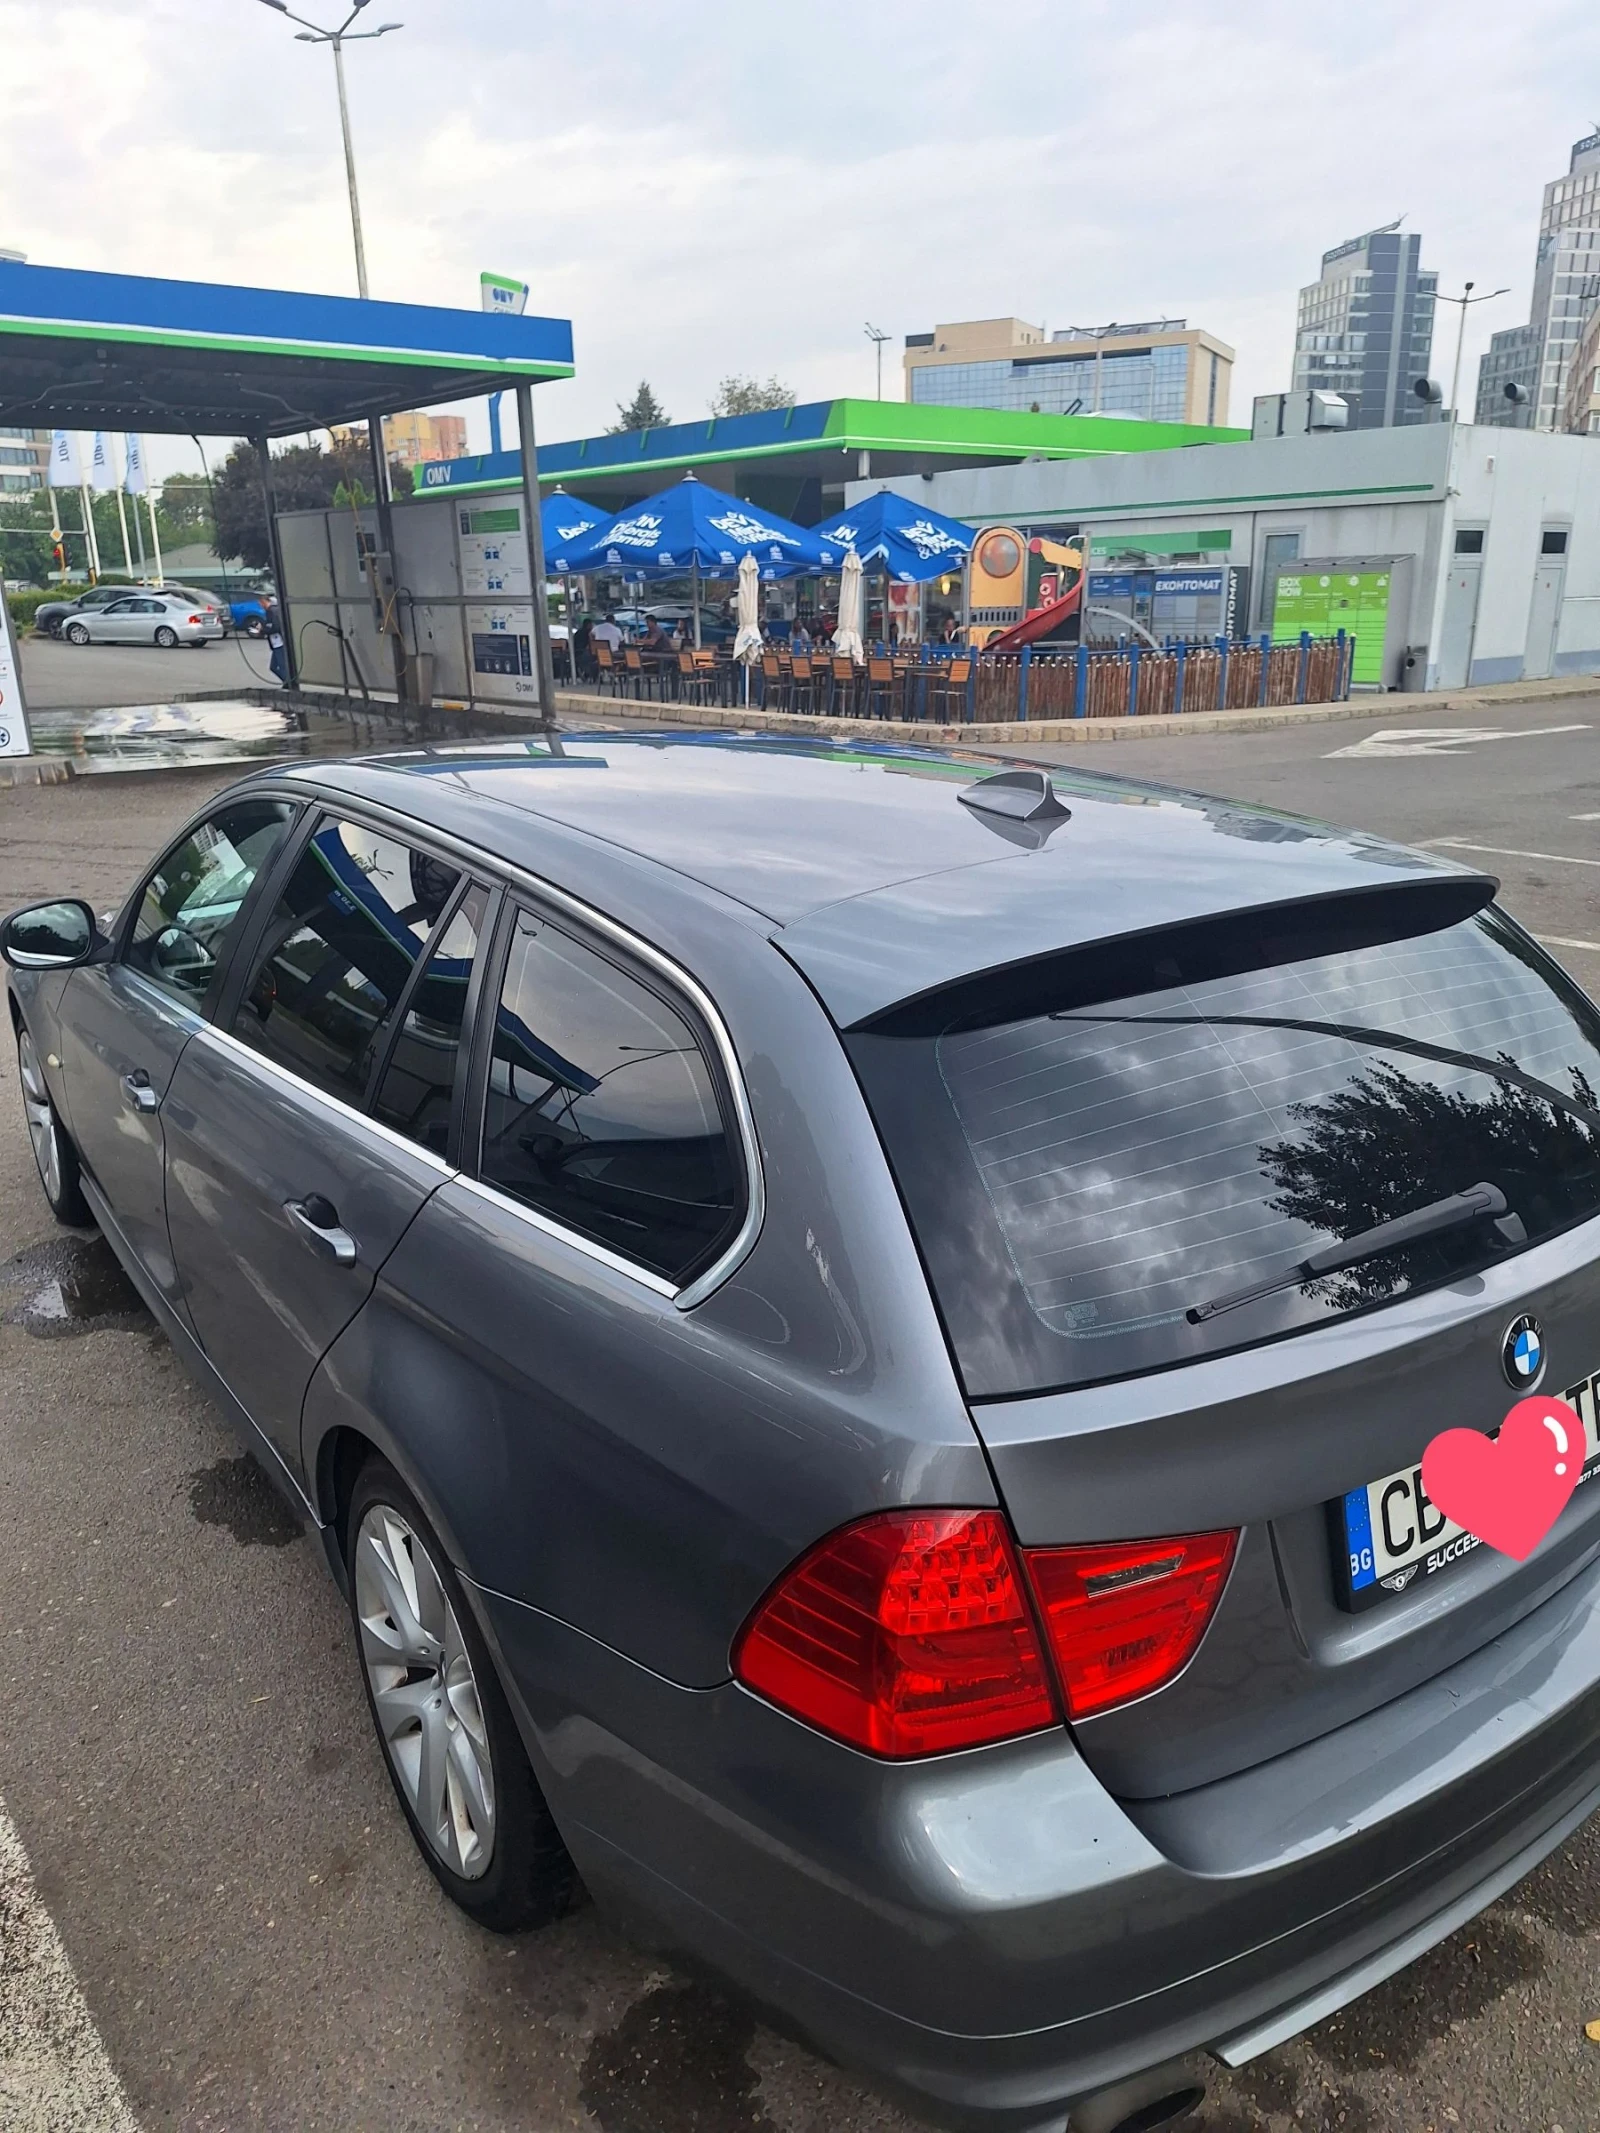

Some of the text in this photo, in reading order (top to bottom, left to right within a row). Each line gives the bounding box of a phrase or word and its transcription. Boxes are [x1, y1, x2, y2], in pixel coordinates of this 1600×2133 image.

[426, 464, 451, 485] OMV
[1155, 579, 1222, 592] ЕКОНТОМАТ
[1278, 587, 1302, 597] NOW
[1279, 577, 1301, 587] BOX
[1508, 1317, 1541, 1346] BMW
[1350, 1547, 1373, 1577] BG
[1427, 1532, 1484, 1575] SUCCES
